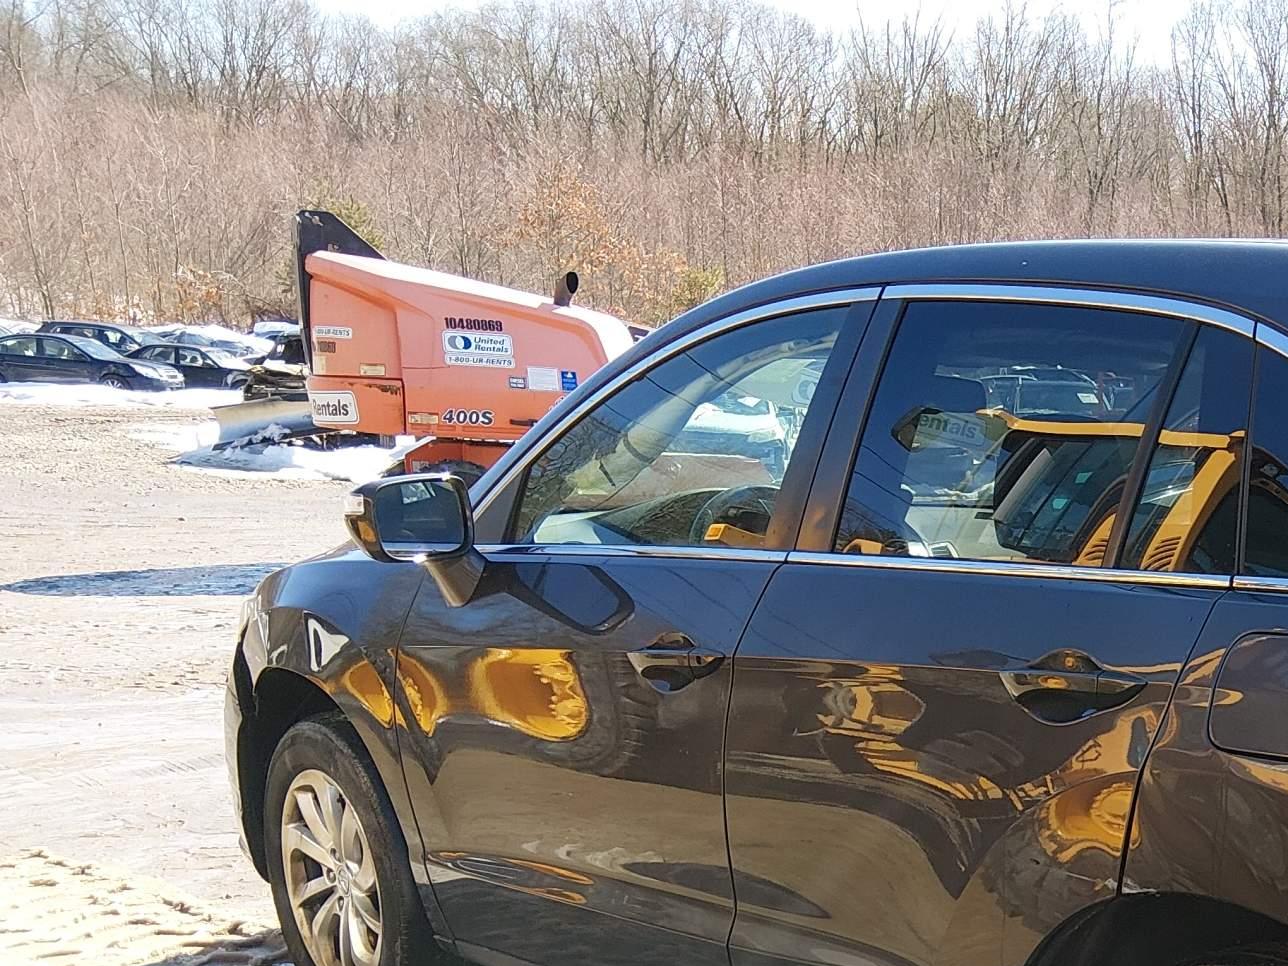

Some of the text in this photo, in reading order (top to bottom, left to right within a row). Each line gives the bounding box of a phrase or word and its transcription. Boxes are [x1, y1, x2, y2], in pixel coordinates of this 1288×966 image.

[474, 337, 505, 346] United
[474, 345, 509, 353] Rentals
[448, 356, 512, 366] 1-800-UR-RENTS
[442, 408, 495, 426] 400S
[919, 414, 977, 439] entals
